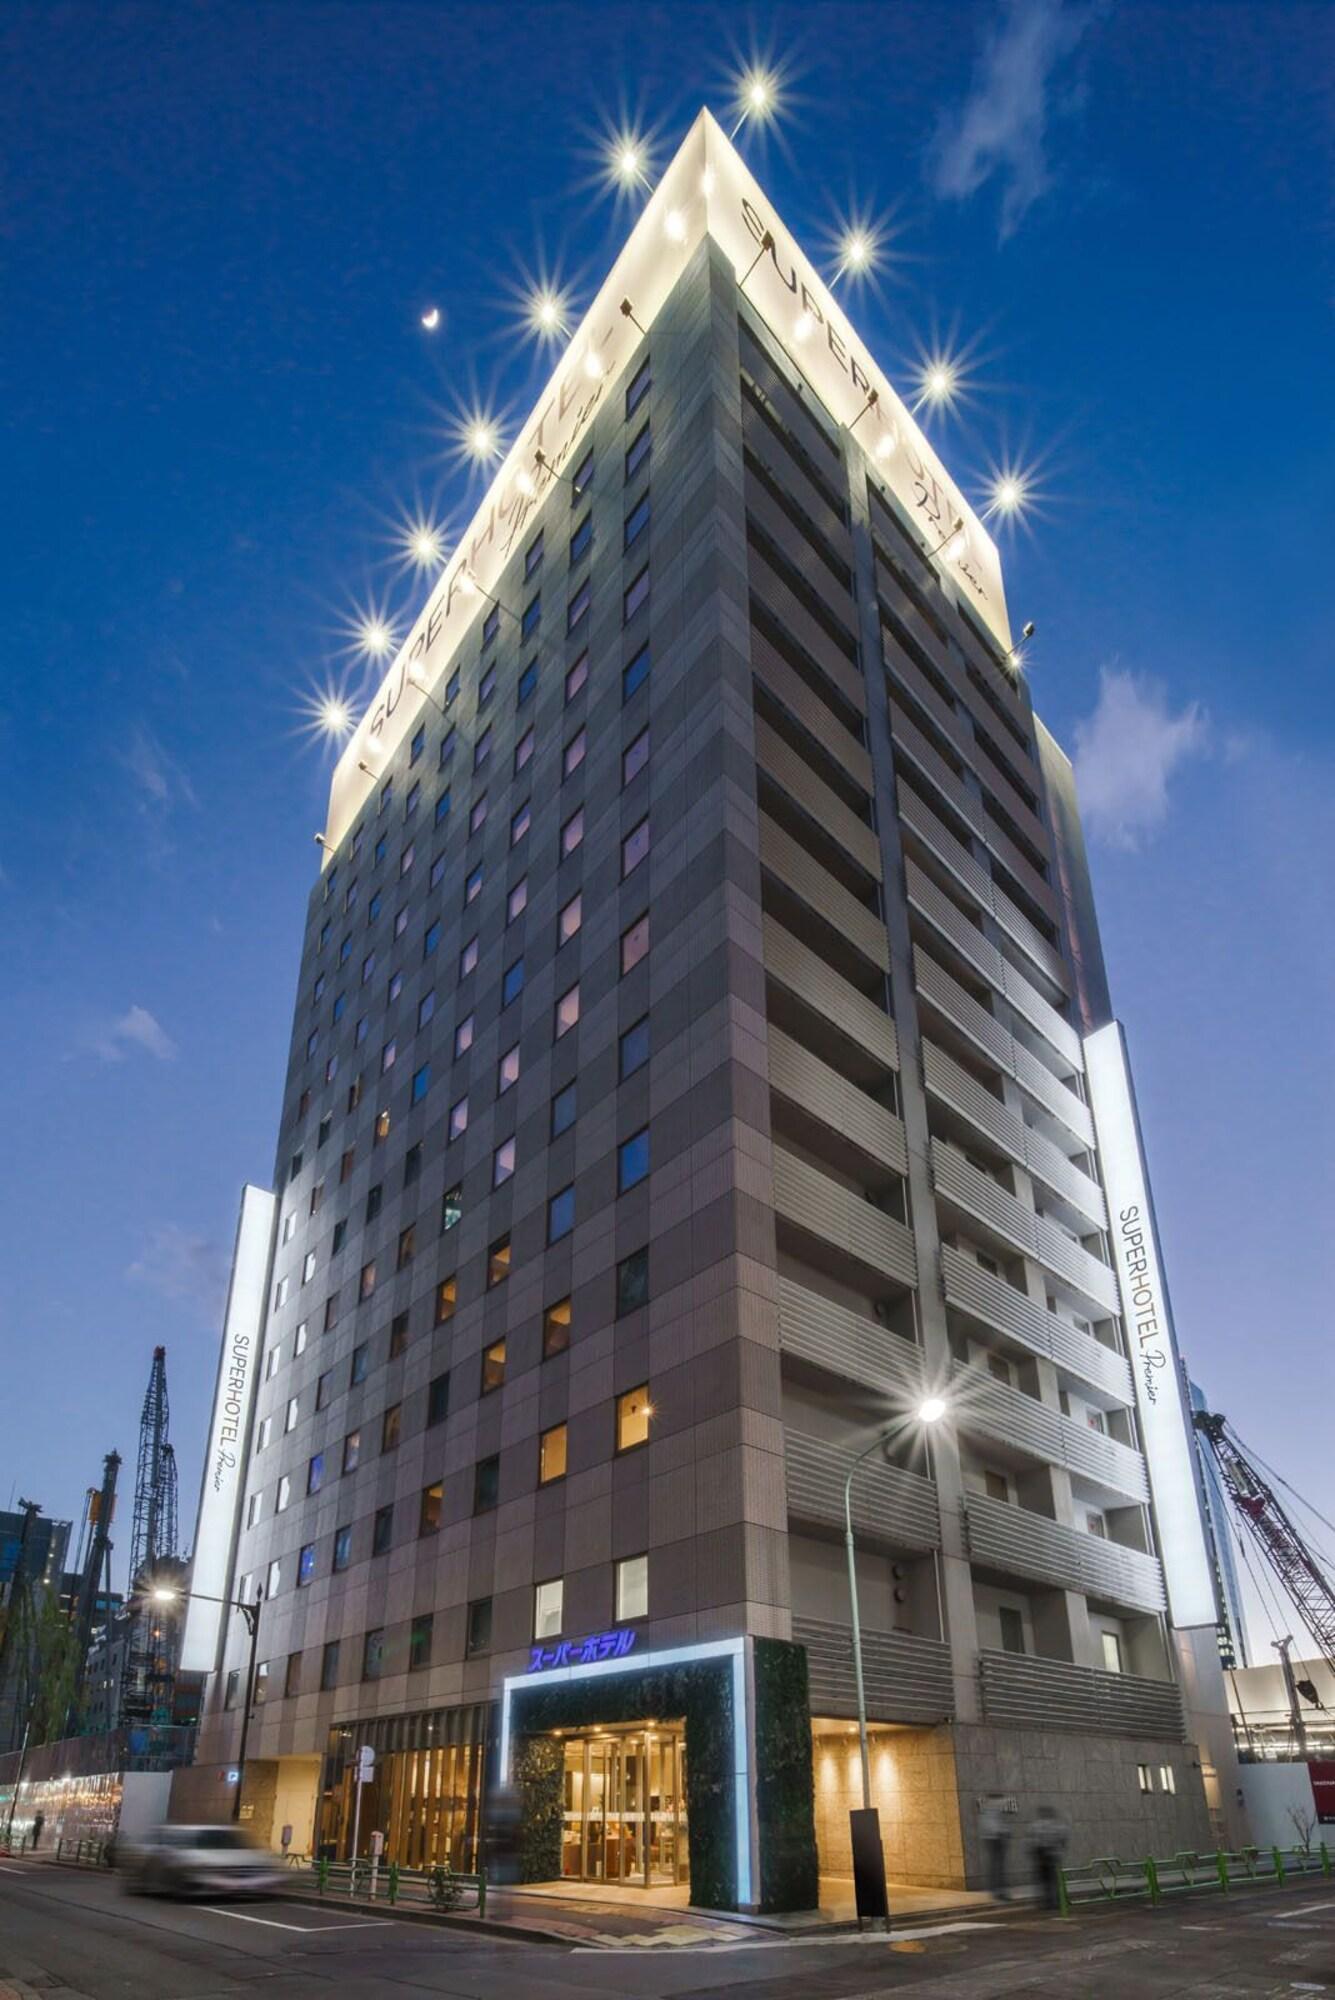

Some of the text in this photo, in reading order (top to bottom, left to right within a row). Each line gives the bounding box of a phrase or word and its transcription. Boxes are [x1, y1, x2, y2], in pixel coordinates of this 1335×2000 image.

[1120, 1205, 1166, 1405] SUPERHOTEL Premier
[215, 1333, 250, 1493] SUPERHOTEL Premier
[528, 1629, 636, 1673] スーパーホテル
